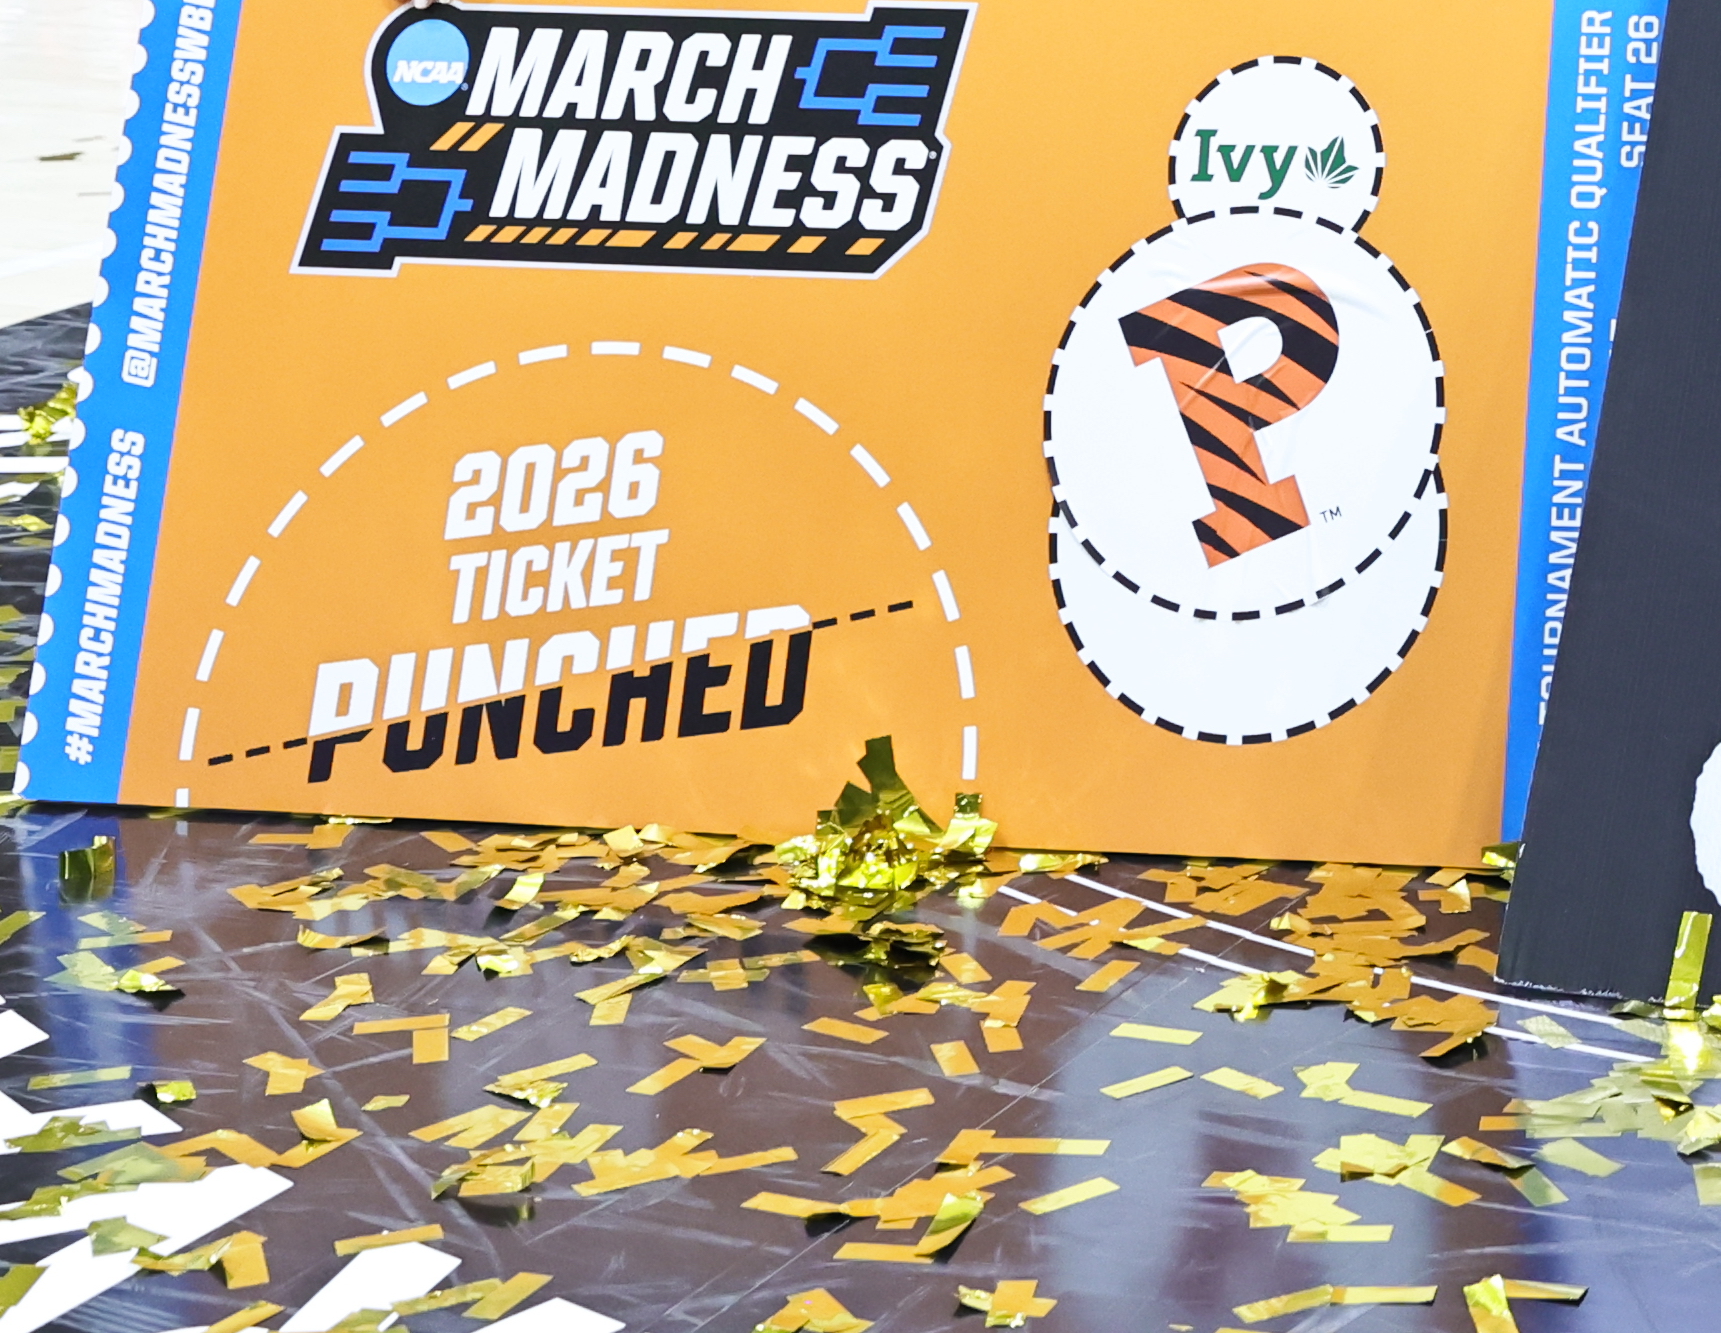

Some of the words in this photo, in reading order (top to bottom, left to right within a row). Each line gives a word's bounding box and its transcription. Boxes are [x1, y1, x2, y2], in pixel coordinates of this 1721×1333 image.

[394, 59, 467, 87] NCAA
[465, 25, 792, 126] MARCH
[1626, 14, 1660, 65] 26
[1569, 9, 1614, 210] QUALIFIER
[488, 129, 925, 230] MADNESS
[1189, 128, 1298, 202] Ivy
[1555, 220, 1599, 446] AUTOMATIC
[1117, 261, 1341, 570] P
[443, 428, 665, 542] 2026
[64, 427, 147, 766] #MARCHMADNESS
[449, 528, 671, 626] TICKET
[307, 604, 815, 784] PUNCHED
